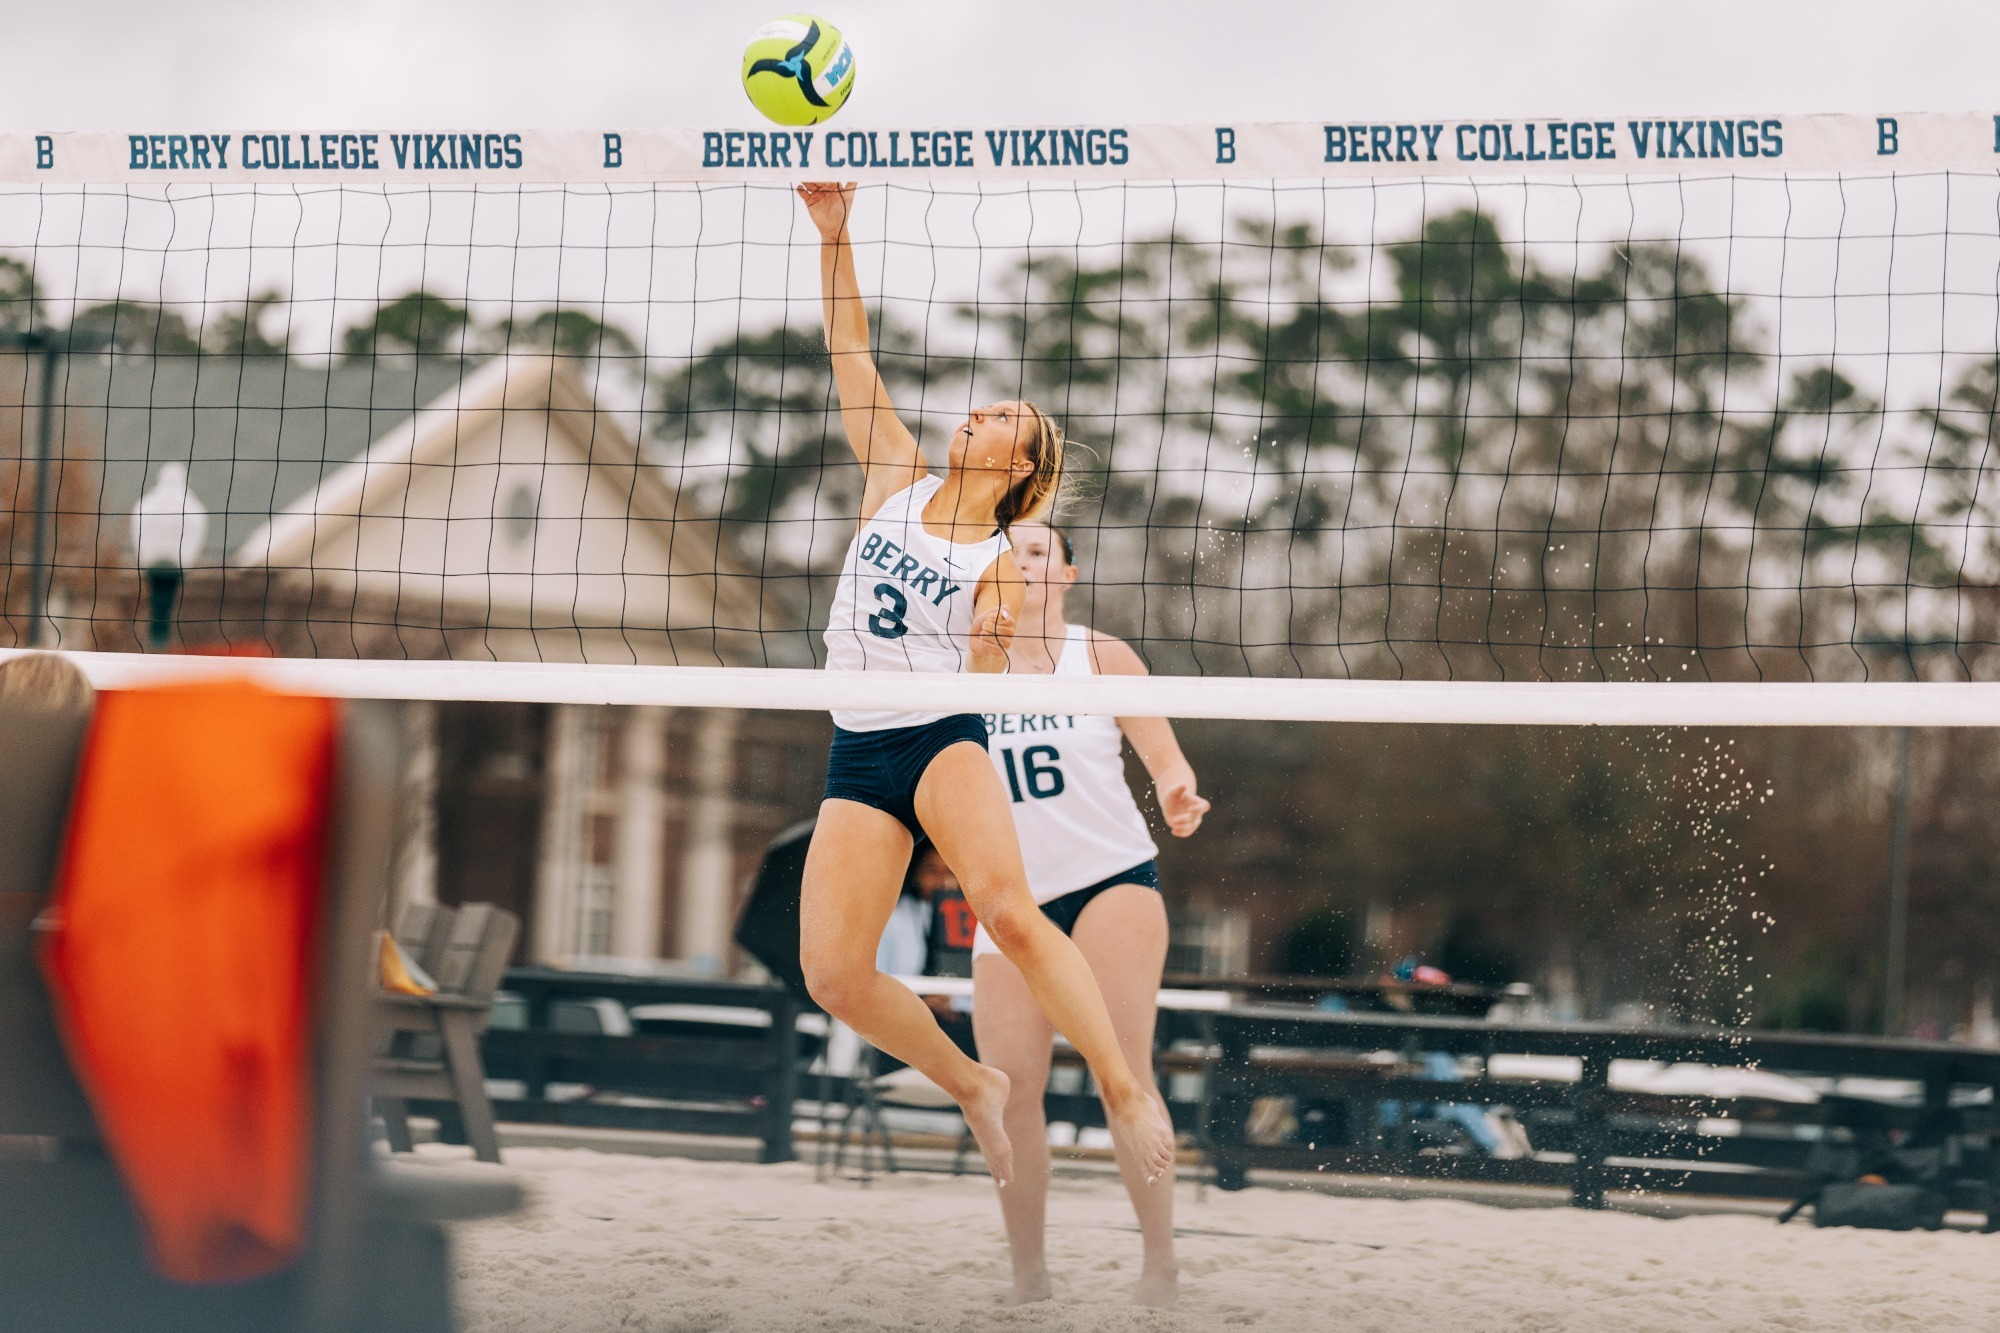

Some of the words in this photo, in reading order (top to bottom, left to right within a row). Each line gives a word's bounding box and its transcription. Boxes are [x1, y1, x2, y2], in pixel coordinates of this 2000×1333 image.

[35, 135, 54, 170] B
[128, 134, 231, 170] BERRY
[241, 134, 380, 170] COLLEGE
[389, 133, 523, 170] VIKINGS
[603, 133, 623, 169] B
[702, 131, 814, 168] BERRY
[825, 130, 974, 168] COLLEGE
[984, 128, 1129, 167] VIKINGS
[1215, 127, 1236, 164] B
[1323, 124, 1444, 163] BERRY
[1455, 121, 1617, 162] COLLEGE
[1627, 119, 1783, 159] VIKINGS
[1876, 117, 1899, 156] B
[859, 532, 961, 607] BERRY
[868, 583, 909, 640] 3
[984, 712, 1077, 736] BERRY
[1001, 744, 1065, 803] 16
